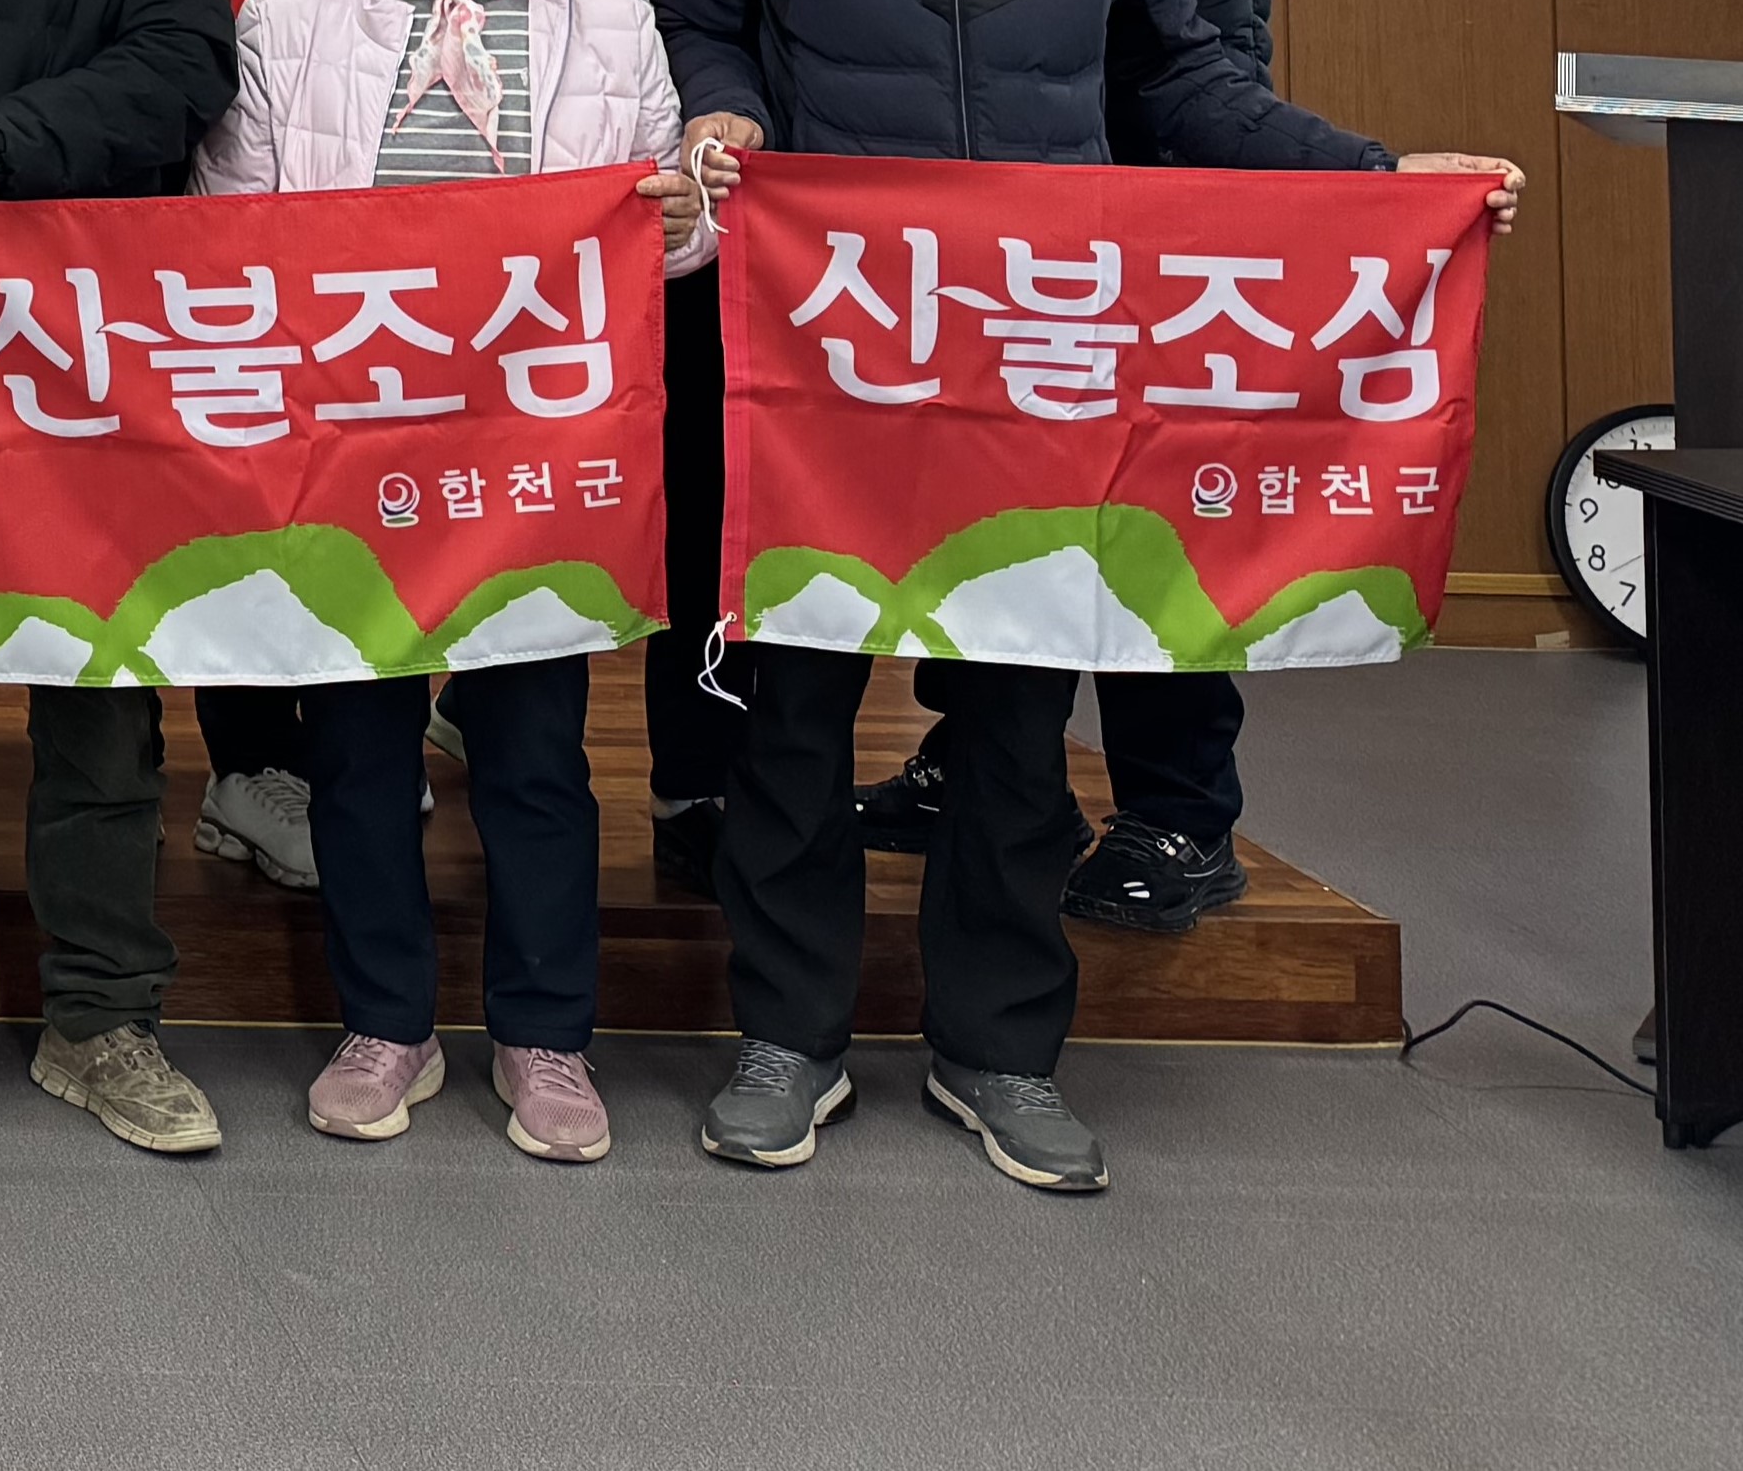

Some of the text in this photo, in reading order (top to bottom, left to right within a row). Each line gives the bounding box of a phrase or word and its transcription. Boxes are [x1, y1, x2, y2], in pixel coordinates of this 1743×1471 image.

[788, 227, 1453, 422] 산불조심
[437, 458, 625, 520] 합천군
[1257, 463, 1441, 517] 합천군
[1579, 497, 1599, 524] 9
[1587, 543, 1607, 572] 8
[1619, 580, 1637, 607] 7
